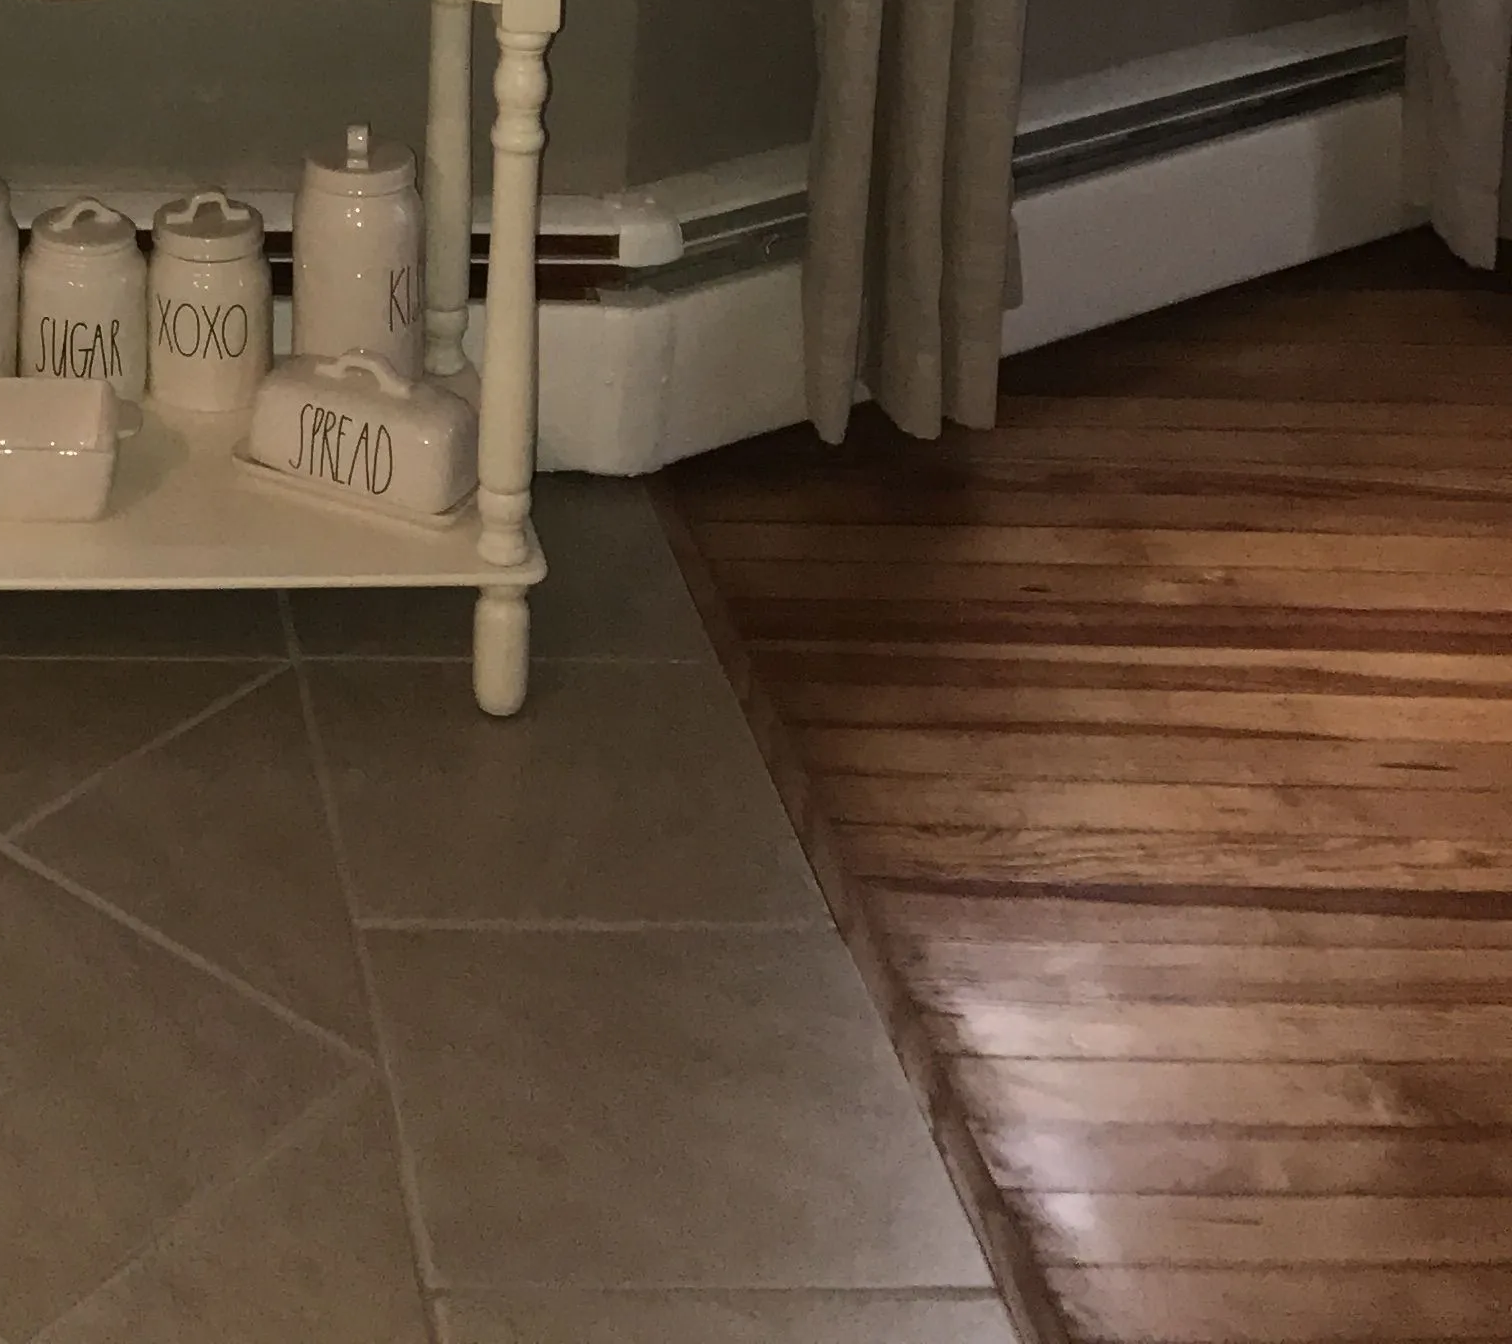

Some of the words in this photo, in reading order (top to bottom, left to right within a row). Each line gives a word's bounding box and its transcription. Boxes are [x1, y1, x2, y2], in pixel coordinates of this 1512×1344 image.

[35, 316, 123, 379] SUGAR
[157, 293, 248, 360] XOXO
[289, 404, 394, 496] SPREAD
